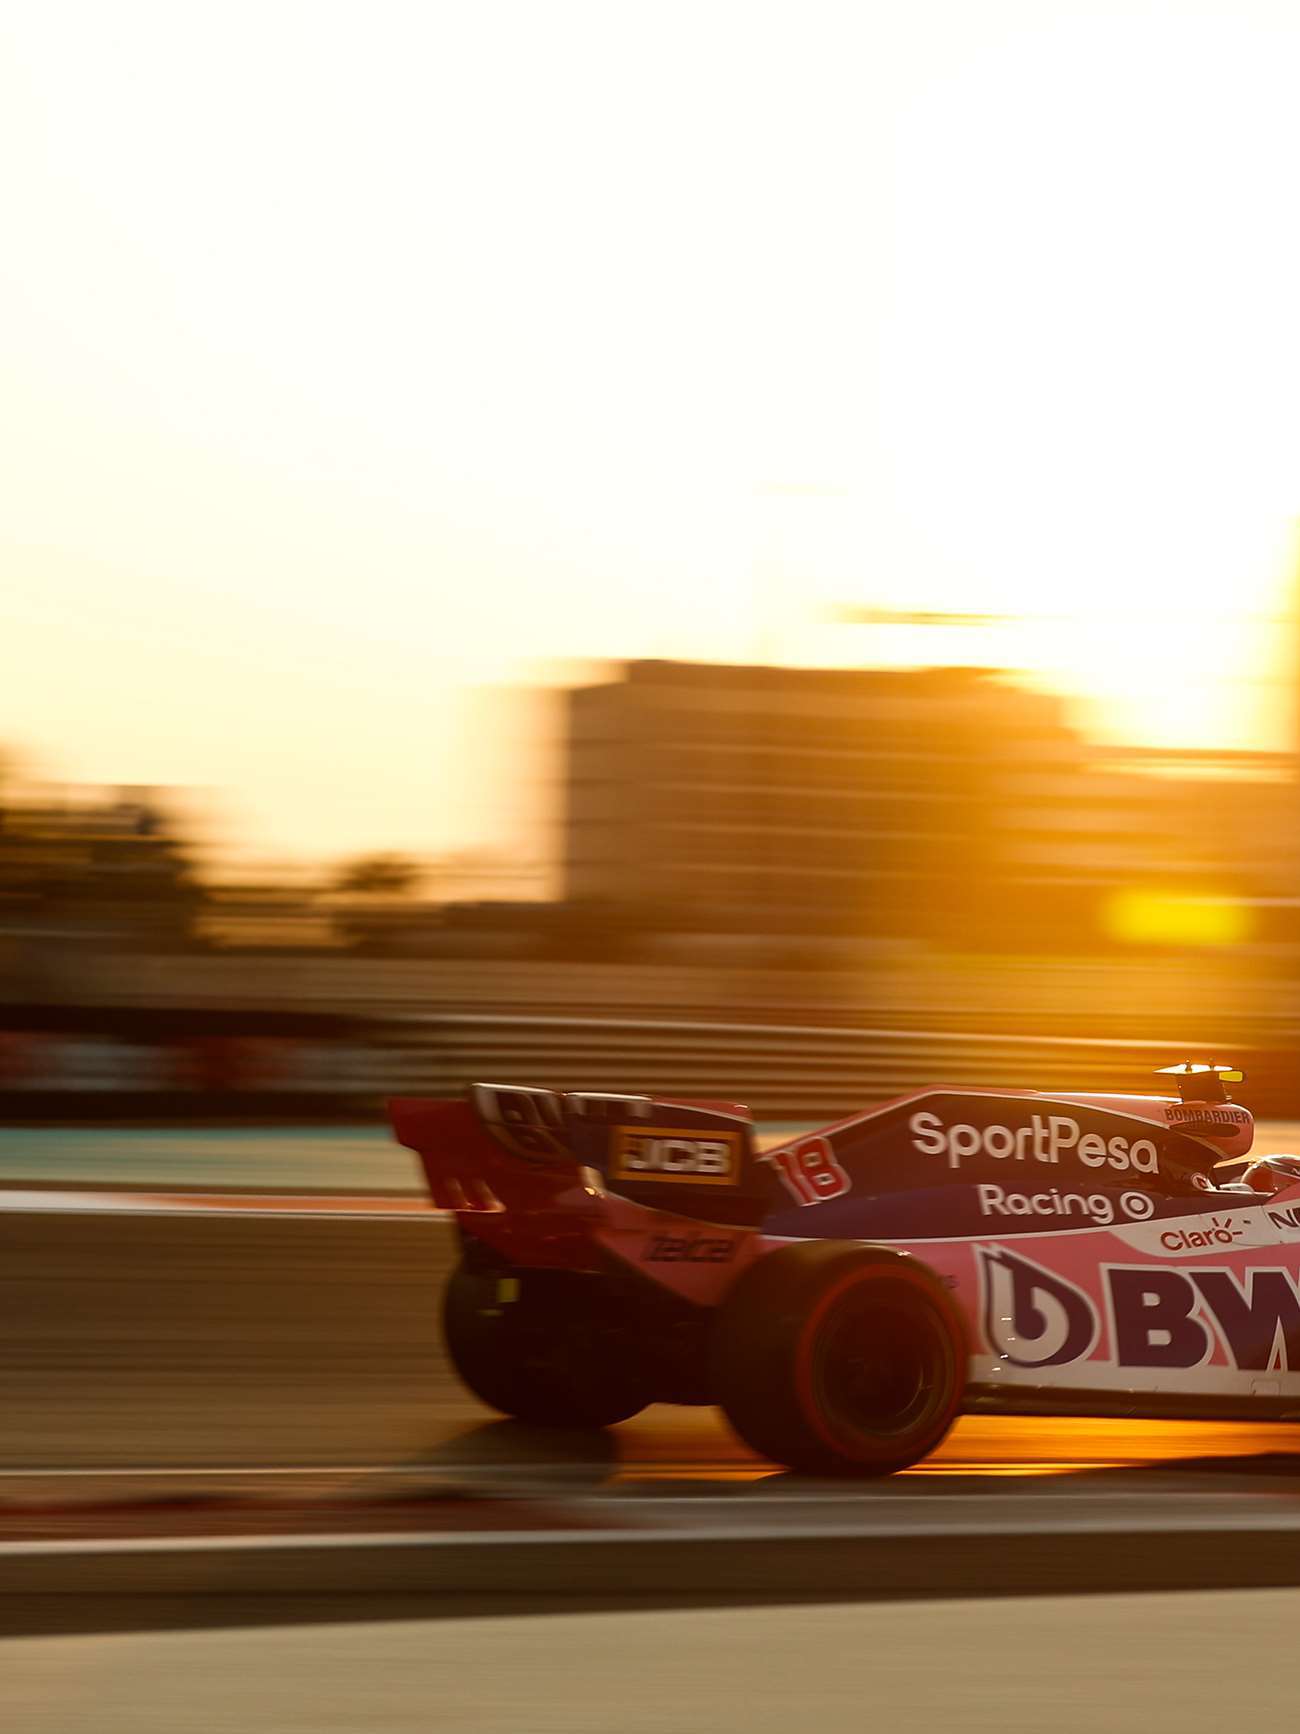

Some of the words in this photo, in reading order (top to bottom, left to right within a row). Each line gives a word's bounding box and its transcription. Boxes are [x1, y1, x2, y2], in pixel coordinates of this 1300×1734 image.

[1164, 1107, 1250, 1124] BOMBARDIER
[624, 1138, 730, 1173] JCB
[909, 1111, 1159, 1174] SportPesa
[770, 1136, 852, 1206] 18
[976, 1184, 1114, 1224] Racing
[1160, 1223, 1233, 1251] Claro
